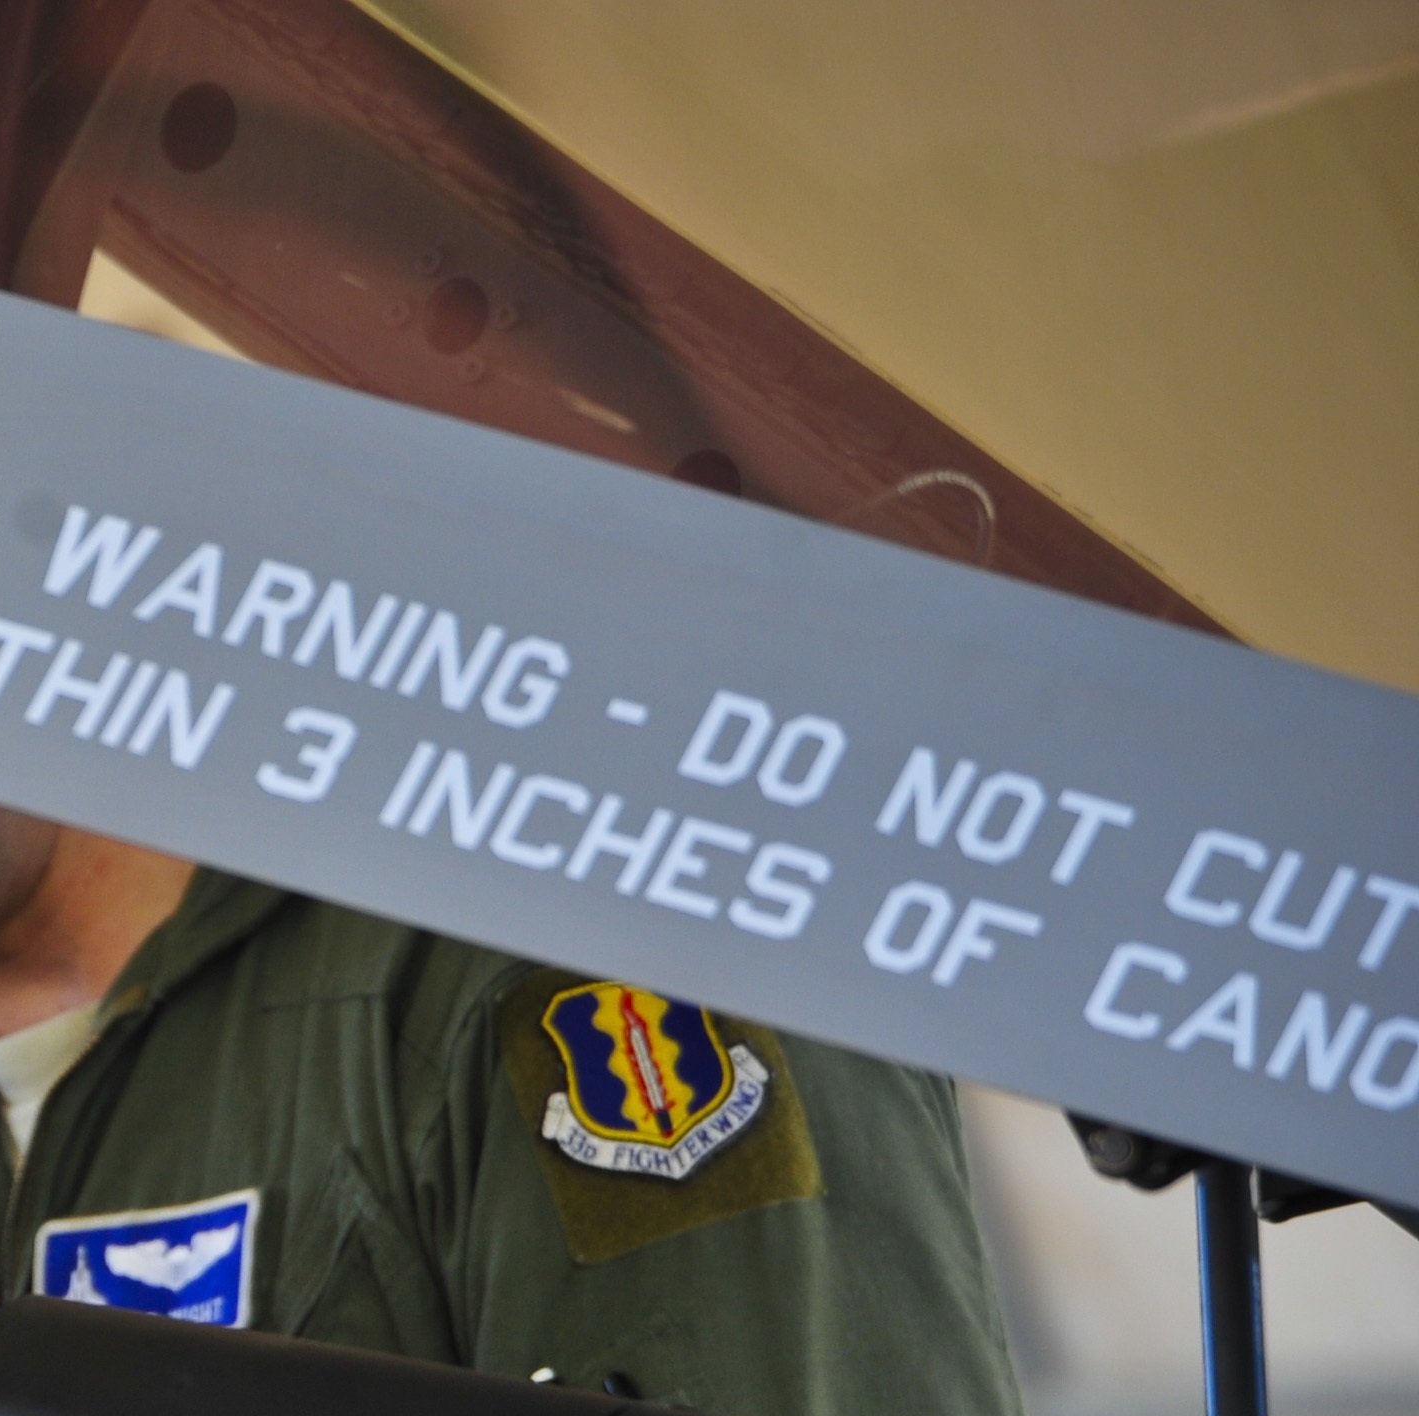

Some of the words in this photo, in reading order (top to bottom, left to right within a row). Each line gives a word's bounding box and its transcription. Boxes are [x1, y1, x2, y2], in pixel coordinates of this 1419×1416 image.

[45, 505, 568, 727] WARNING
[609, 700, 645, 723] -
[679, 691, 845, 805] DO
[877, 747, 1132, 884] NOT
[1166, 829, 1419, 971] CUT
[256, 706, 357, 803] 3
[380, 741, 831, 938] INCHES
[863, 881, 1042, 985] OF
[613, 1131, 714, 1174] FIGHTER
[715, 1080, 760, 1134] WING
